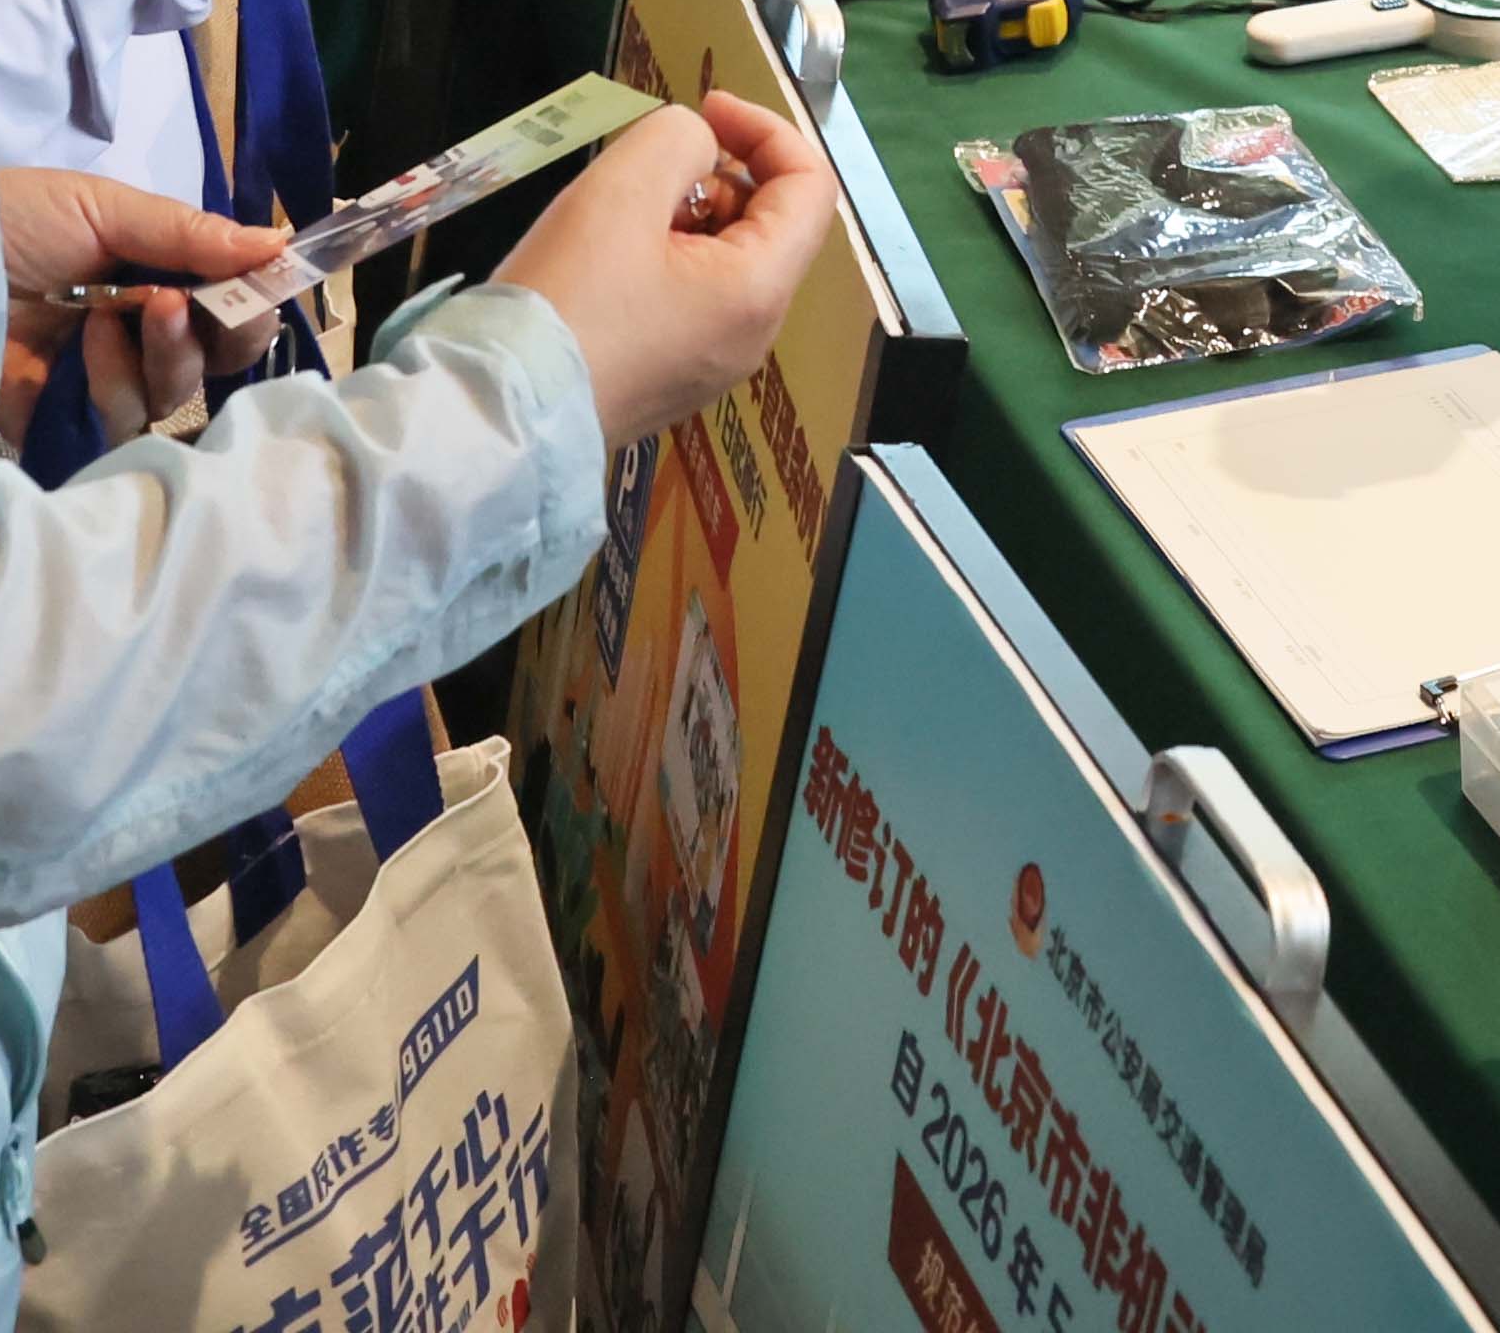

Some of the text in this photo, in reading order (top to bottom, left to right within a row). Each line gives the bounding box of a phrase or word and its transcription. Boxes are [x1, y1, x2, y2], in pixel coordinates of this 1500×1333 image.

[400, 984, 476, 1085] 96110
[1046, 926, 1269, 1289] 北京市公安局交通管理局
